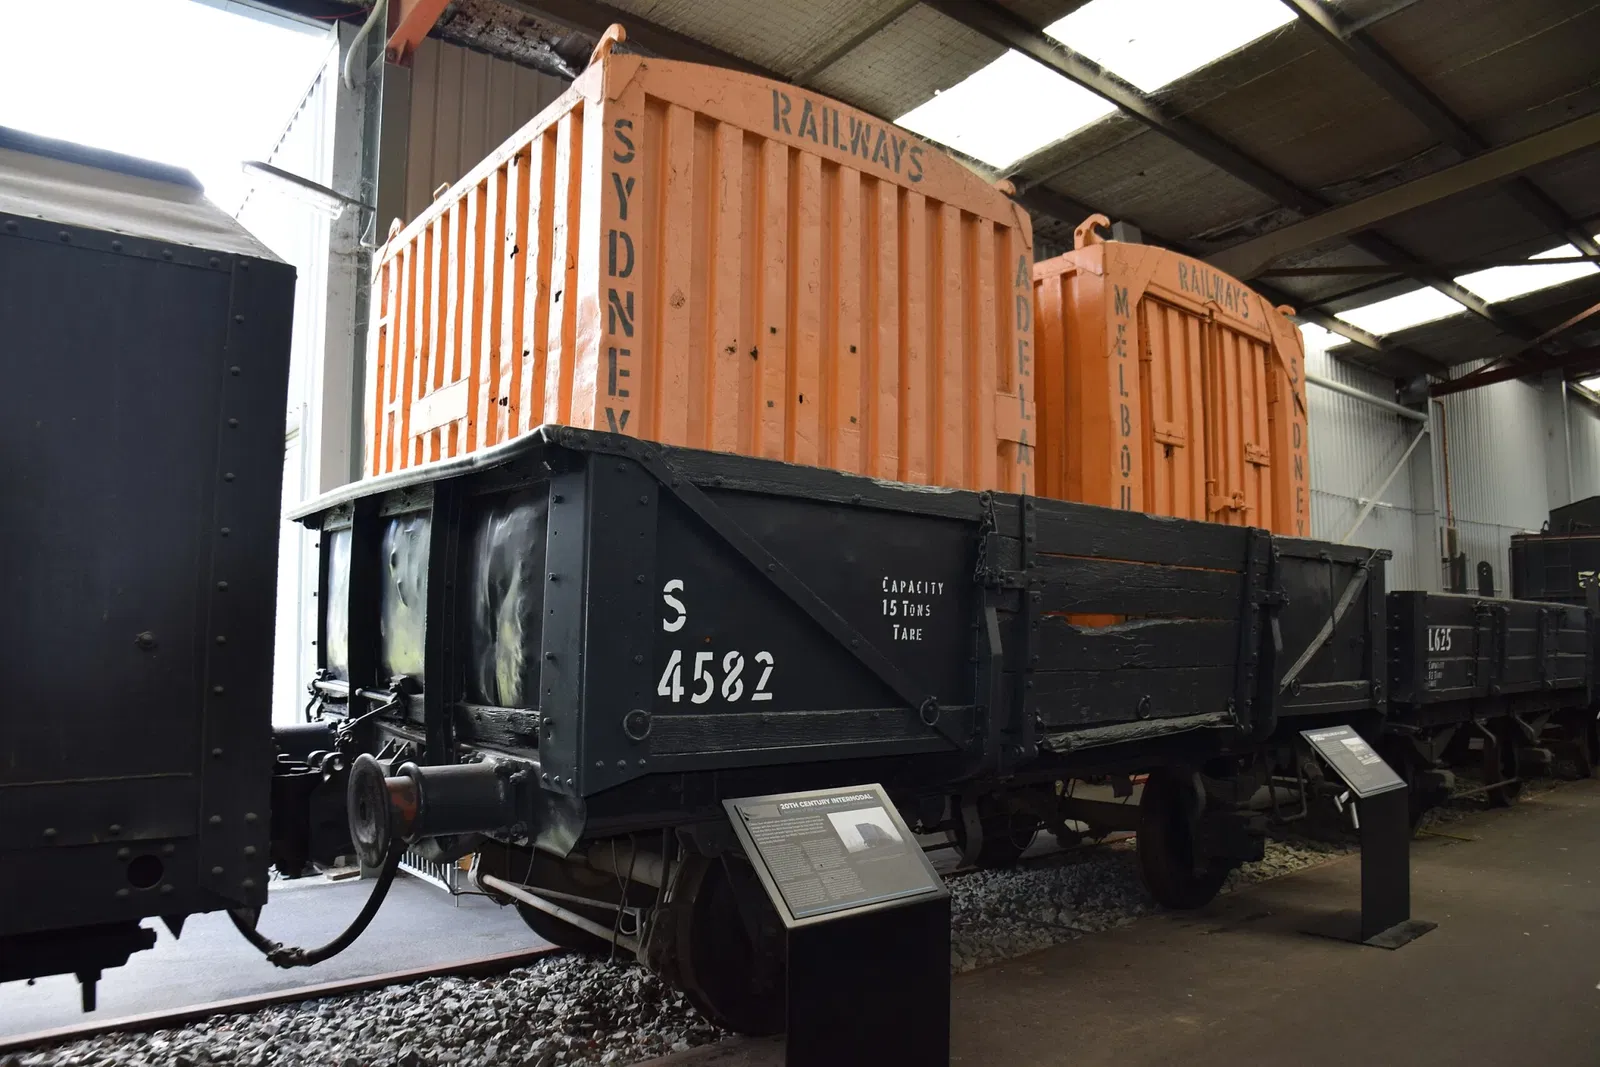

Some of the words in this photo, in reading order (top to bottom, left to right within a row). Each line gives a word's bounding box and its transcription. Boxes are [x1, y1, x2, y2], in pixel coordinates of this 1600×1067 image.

[772, 89, 925, 183] RAILWAYS
[605, 118, 635, 434] SYDNEY
[1178, 260, 1249, 319] RAILWAYS
[882, 576, 944, 595] CAPACITY
[663, 578, 687, 632] S
[882, 599, 897, 616] 15
[902, 600, 931, 617] TONS
[893, 624, 922, 641] TARE
[1428, 628, 1452, 651] L625
[657, 649, 775, 704] 4582
[780, 802, 799, 810] 20TH
[799, 799, 830, 808] CENTURY
[830, 793, 874, 804] INTERMODAL
